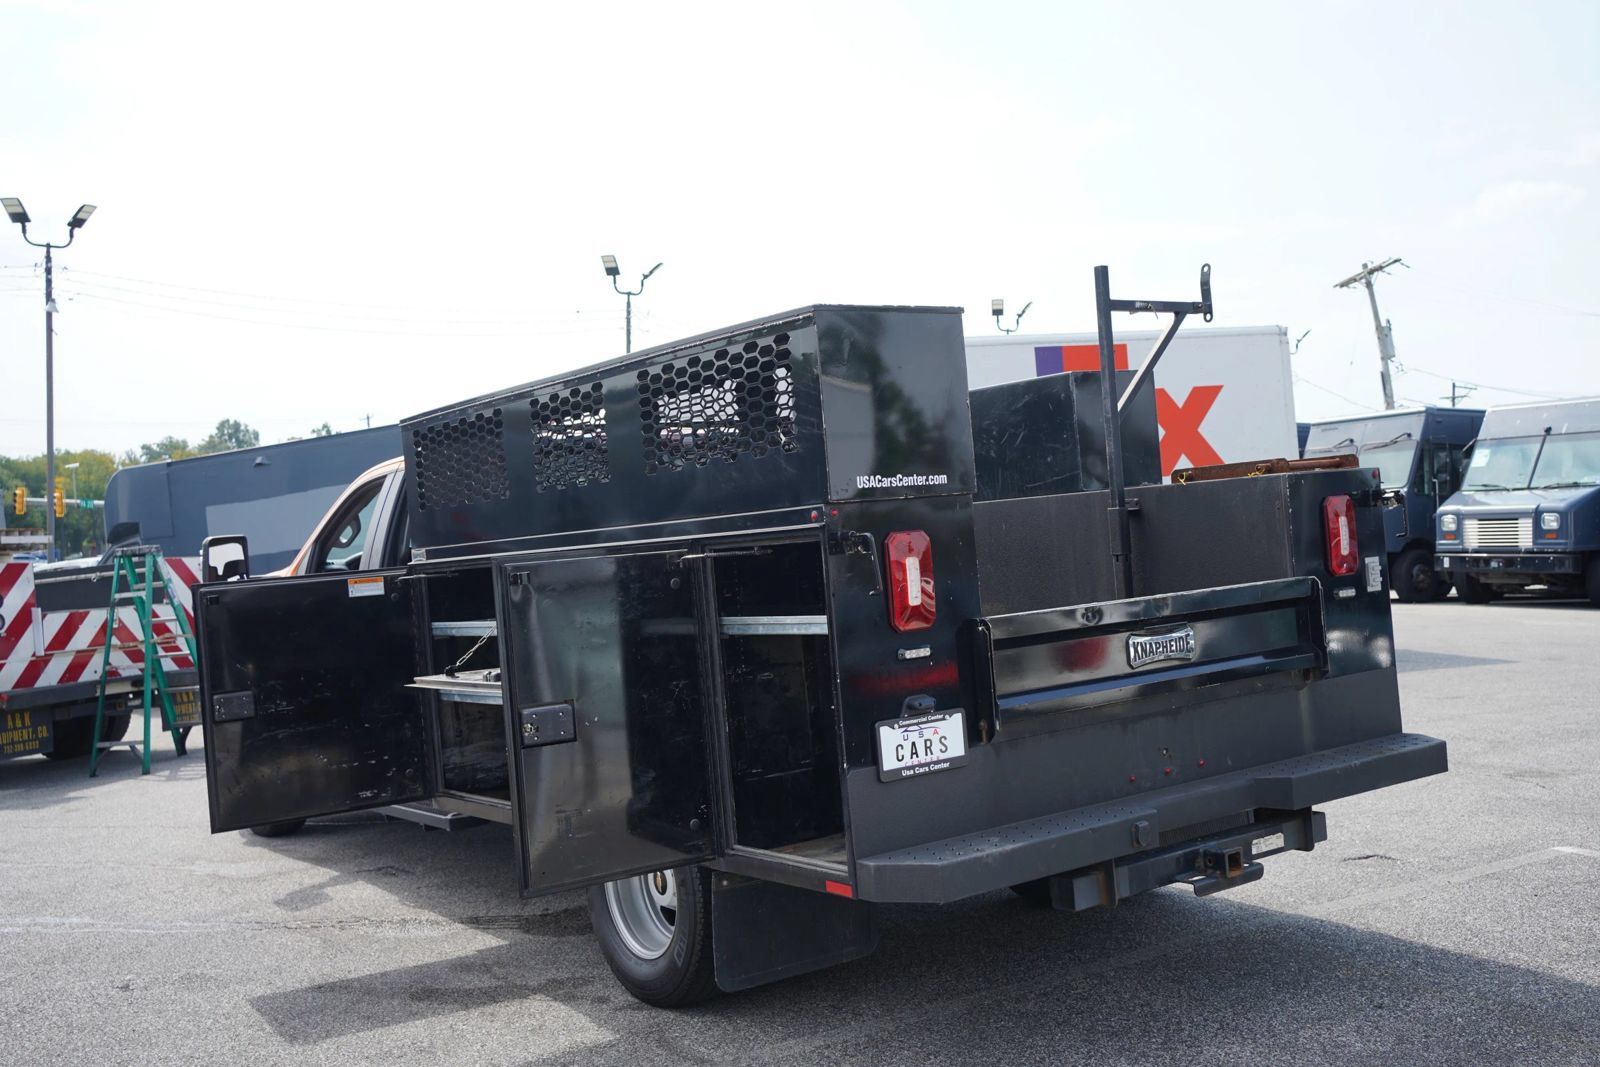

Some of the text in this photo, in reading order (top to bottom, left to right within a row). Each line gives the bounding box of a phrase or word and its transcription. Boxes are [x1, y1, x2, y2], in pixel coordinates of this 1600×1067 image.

[856, 473, 948, 489] USACarsCenter.com
[1132, 633, 1191, 662] KNAPHEIDE
[7, 714, 14, 729] A
[15, 712, 22, 728] &
[899, 718, 927, 726] Commercial
[895, 736, 948, 762] CARS
[901, 762, 950, 777] Usa Cars Center
